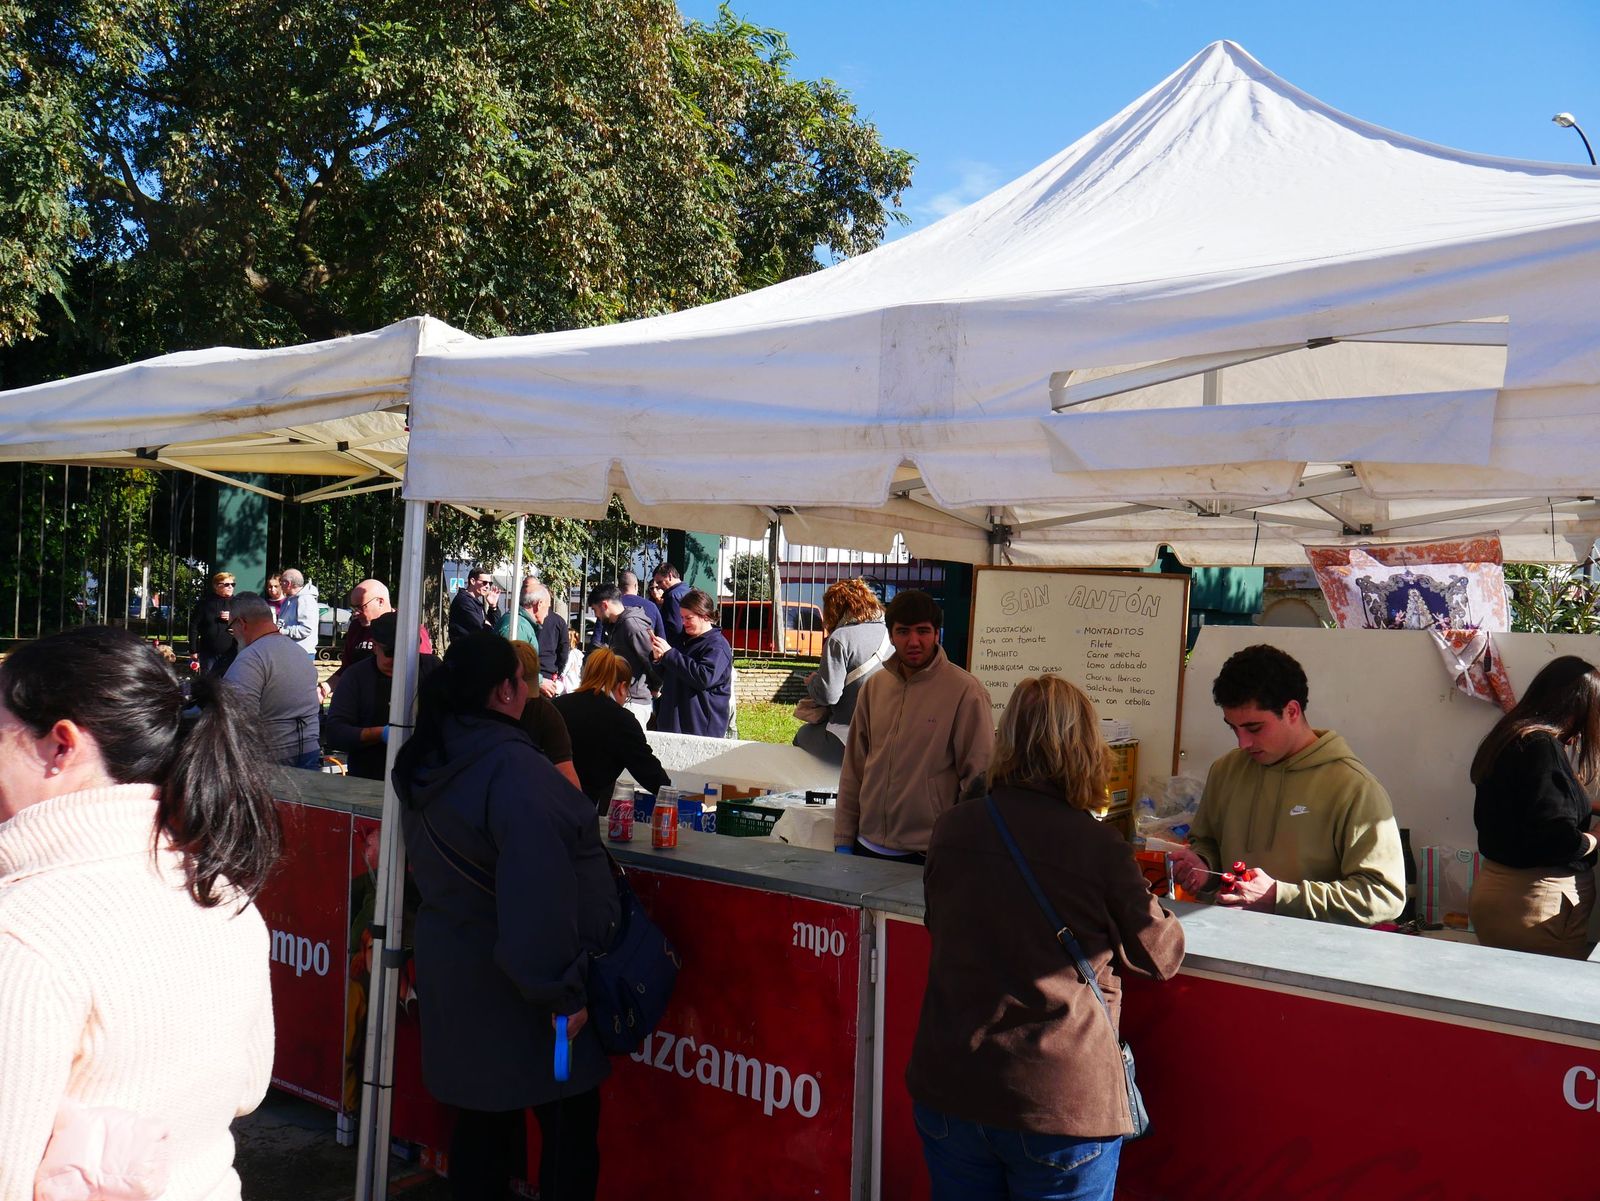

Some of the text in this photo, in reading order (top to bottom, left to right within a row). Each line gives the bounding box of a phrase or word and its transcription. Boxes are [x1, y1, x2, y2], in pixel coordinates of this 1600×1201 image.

[1000, 584, 1160, 617] SAN ANTÓN
[1083, 627, 1144, 636] MONTADITOS
[1018, 635, 1047, 644] tomate
[1090, 639, 1113, 648] Filete
[1086, 650, 1109, 659] Carne
[1109, 660, 1147, 670] adobado
[1124, 697, 1151, 706] cebolla
[1562, 1065, 1600, 1113] C
